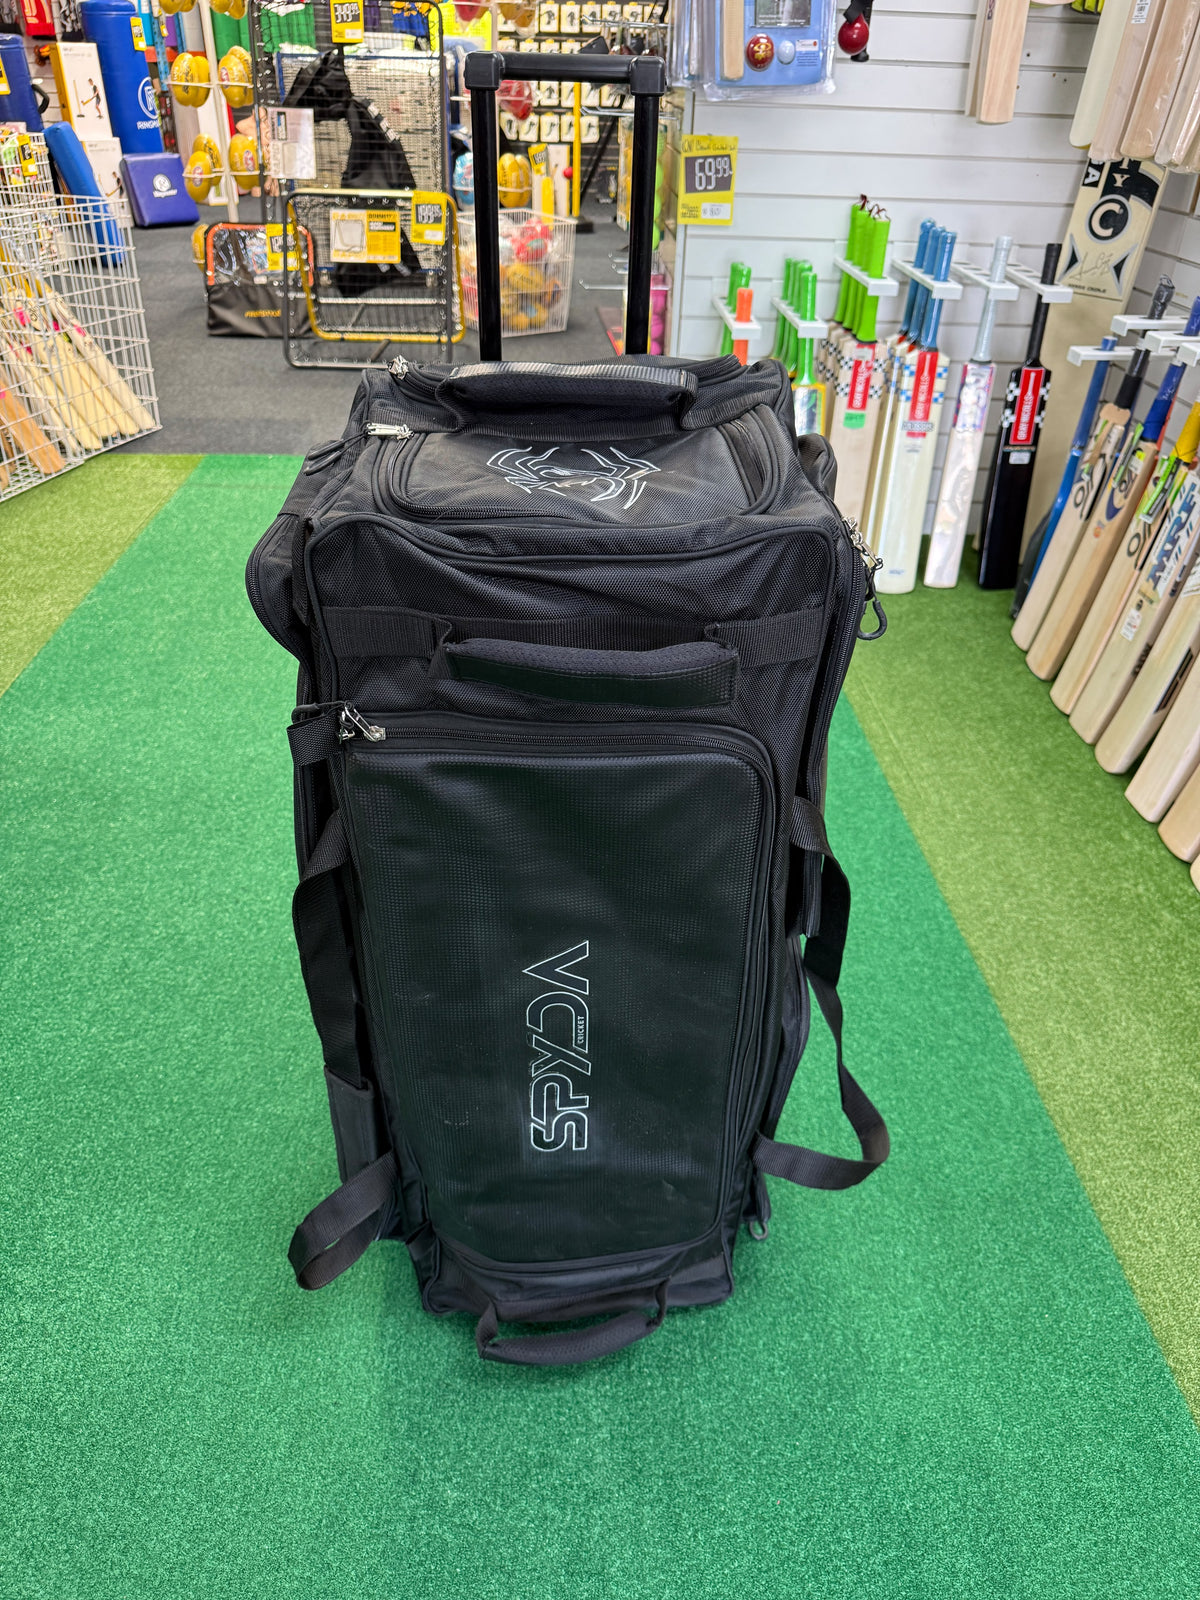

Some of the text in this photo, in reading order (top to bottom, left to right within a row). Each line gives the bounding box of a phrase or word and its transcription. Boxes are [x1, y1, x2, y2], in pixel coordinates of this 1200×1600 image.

[1091, 202, 1121, 237] C
[1019, 394, 1034, 423] NICOLLS
[1016, 423, 1029, 440] GRAY
[1146, 482, 1197, 591] MRF
[521, 939, 592, 1152] SPYDA
[577, 1015, 585, 1044] CRICKET
